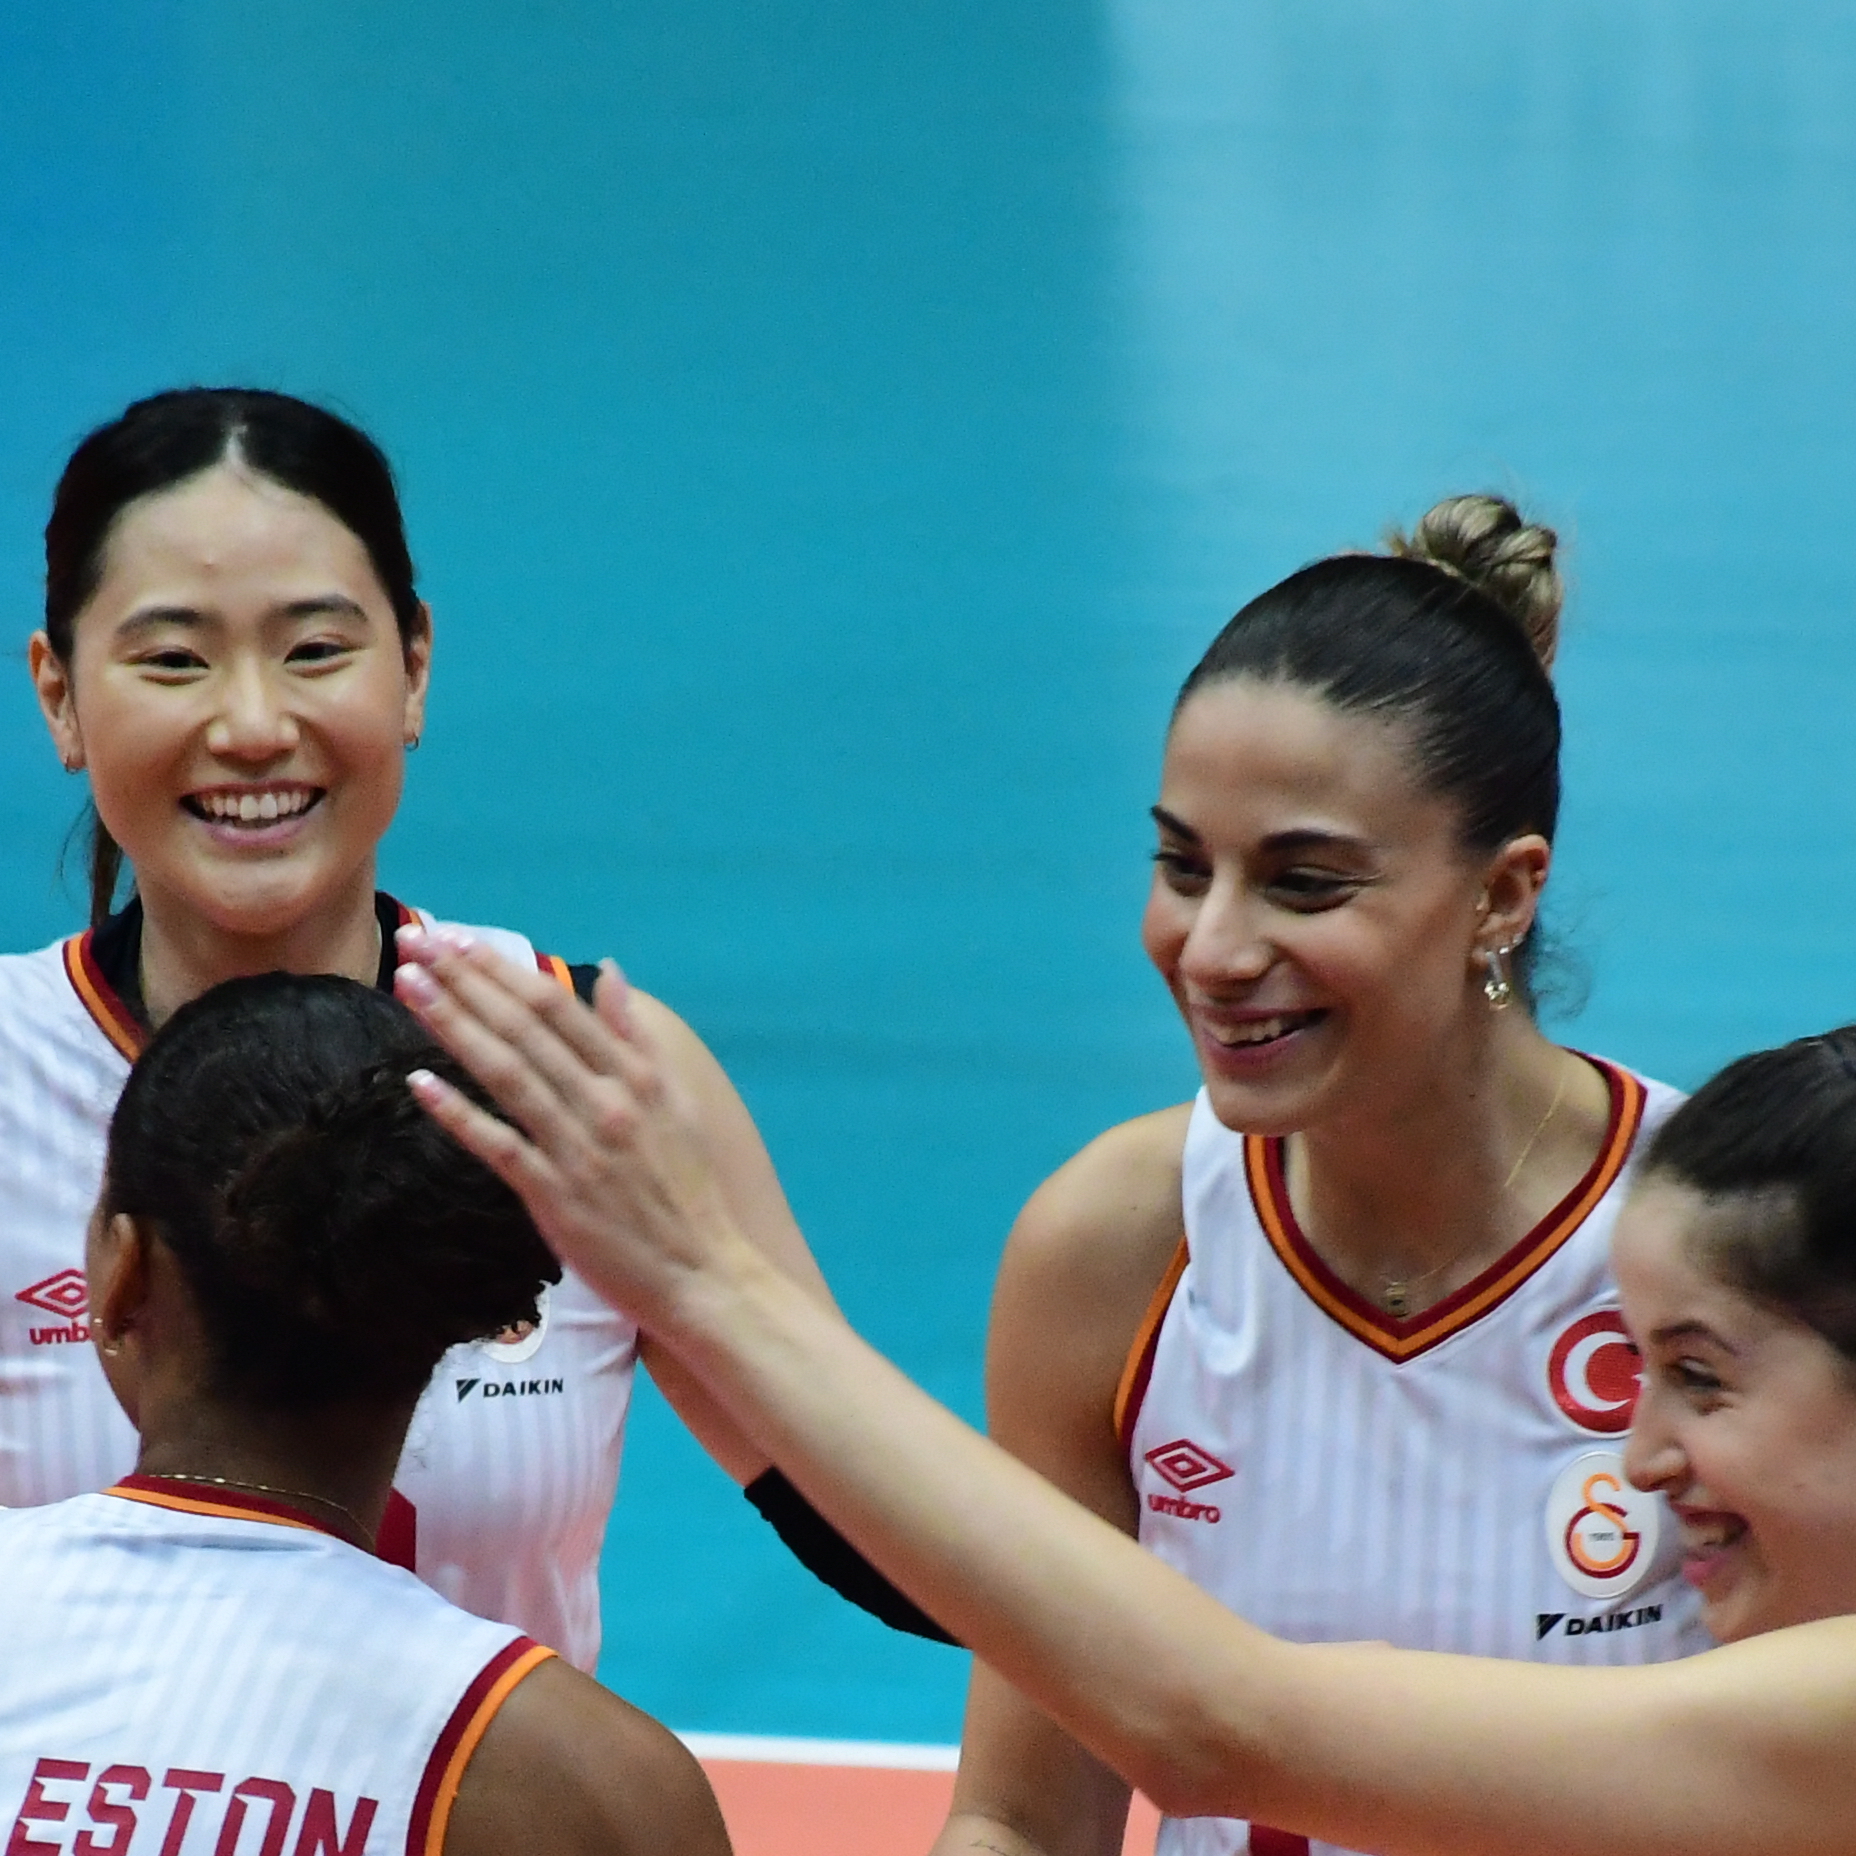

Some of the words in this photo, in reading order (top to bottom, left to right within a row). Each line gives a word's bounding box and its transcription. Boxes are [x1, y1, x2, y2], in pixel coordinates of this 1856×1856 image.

[29, 1321, 91, 1345] umb
[482, 1378, 564, 1398] DAIKIN
[1148, 1494, 1221, 1524] umbro
[1564, 1604, 1663, 1636] DAIKIN
